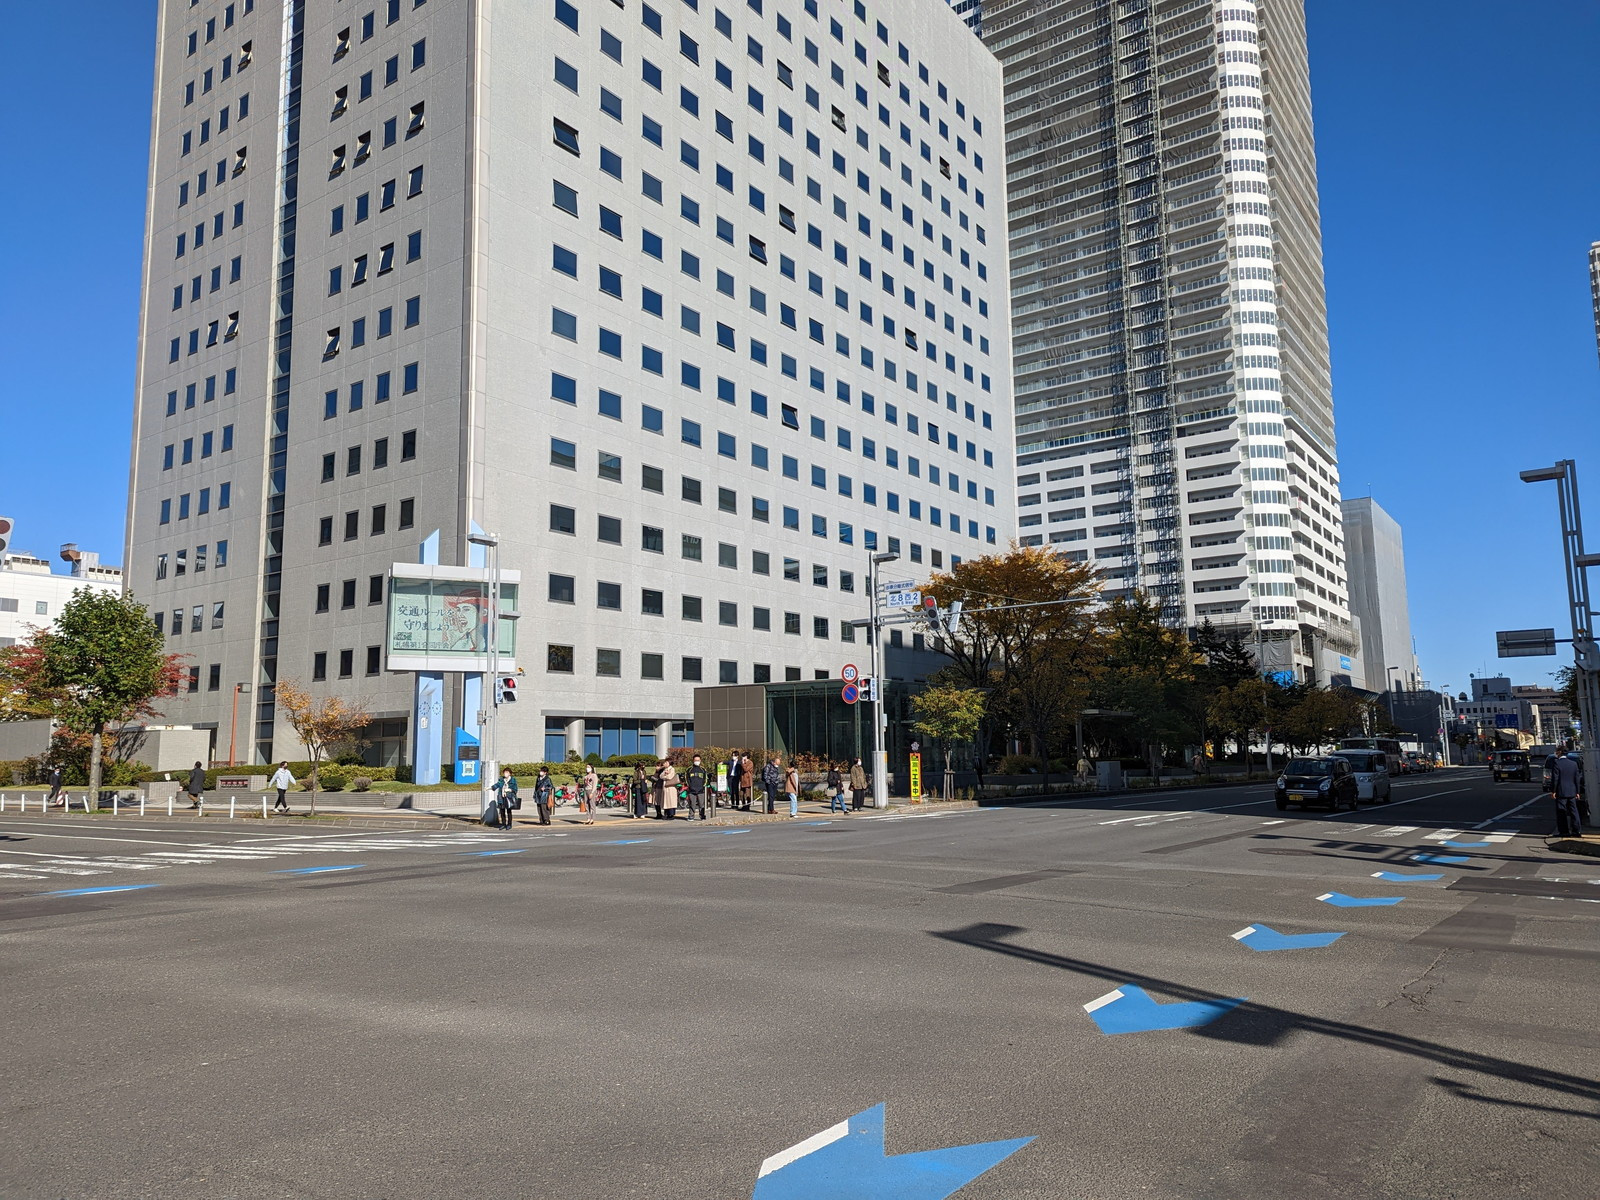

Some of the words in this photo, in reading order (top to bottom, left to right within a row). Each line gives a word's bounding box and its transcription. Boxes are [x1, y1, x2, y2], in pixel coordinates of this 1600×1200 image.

[398, 605, 455, 617] 交通ルールを
[404, 619, 450, 631] 守りましょう
[845, 669, 854, 678] 50
